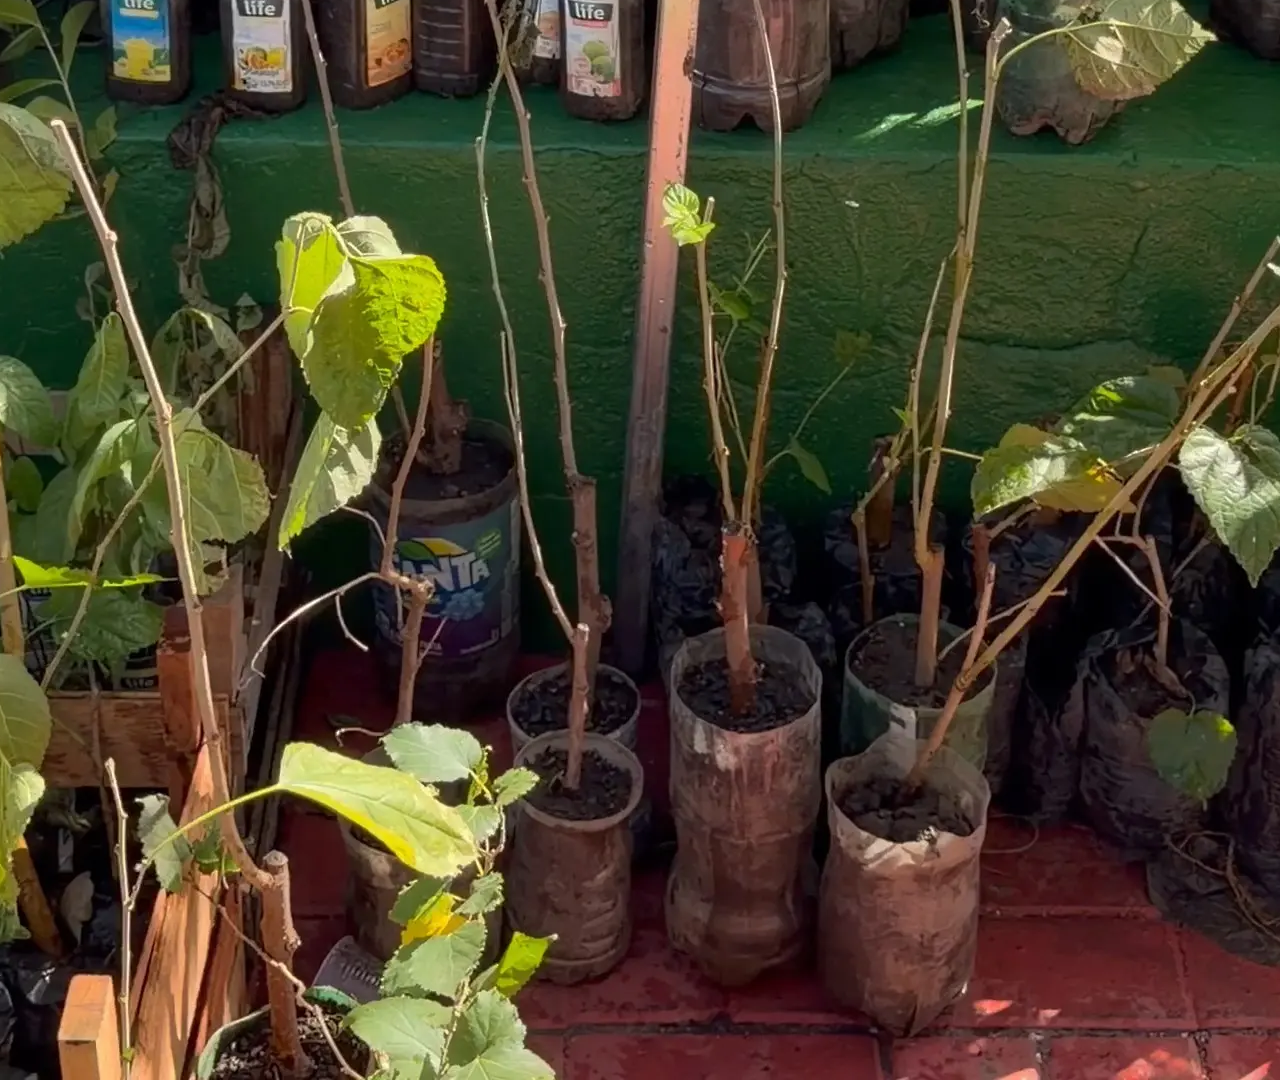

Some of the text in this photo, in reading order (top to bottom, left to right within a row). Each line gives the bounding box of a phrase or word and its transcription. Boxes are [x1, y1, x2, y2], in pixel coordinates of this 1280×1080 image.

[243, 0, 277, 17] life
[574, 1, 606, 21] life
[393, 551, 491, 592] ANTA
